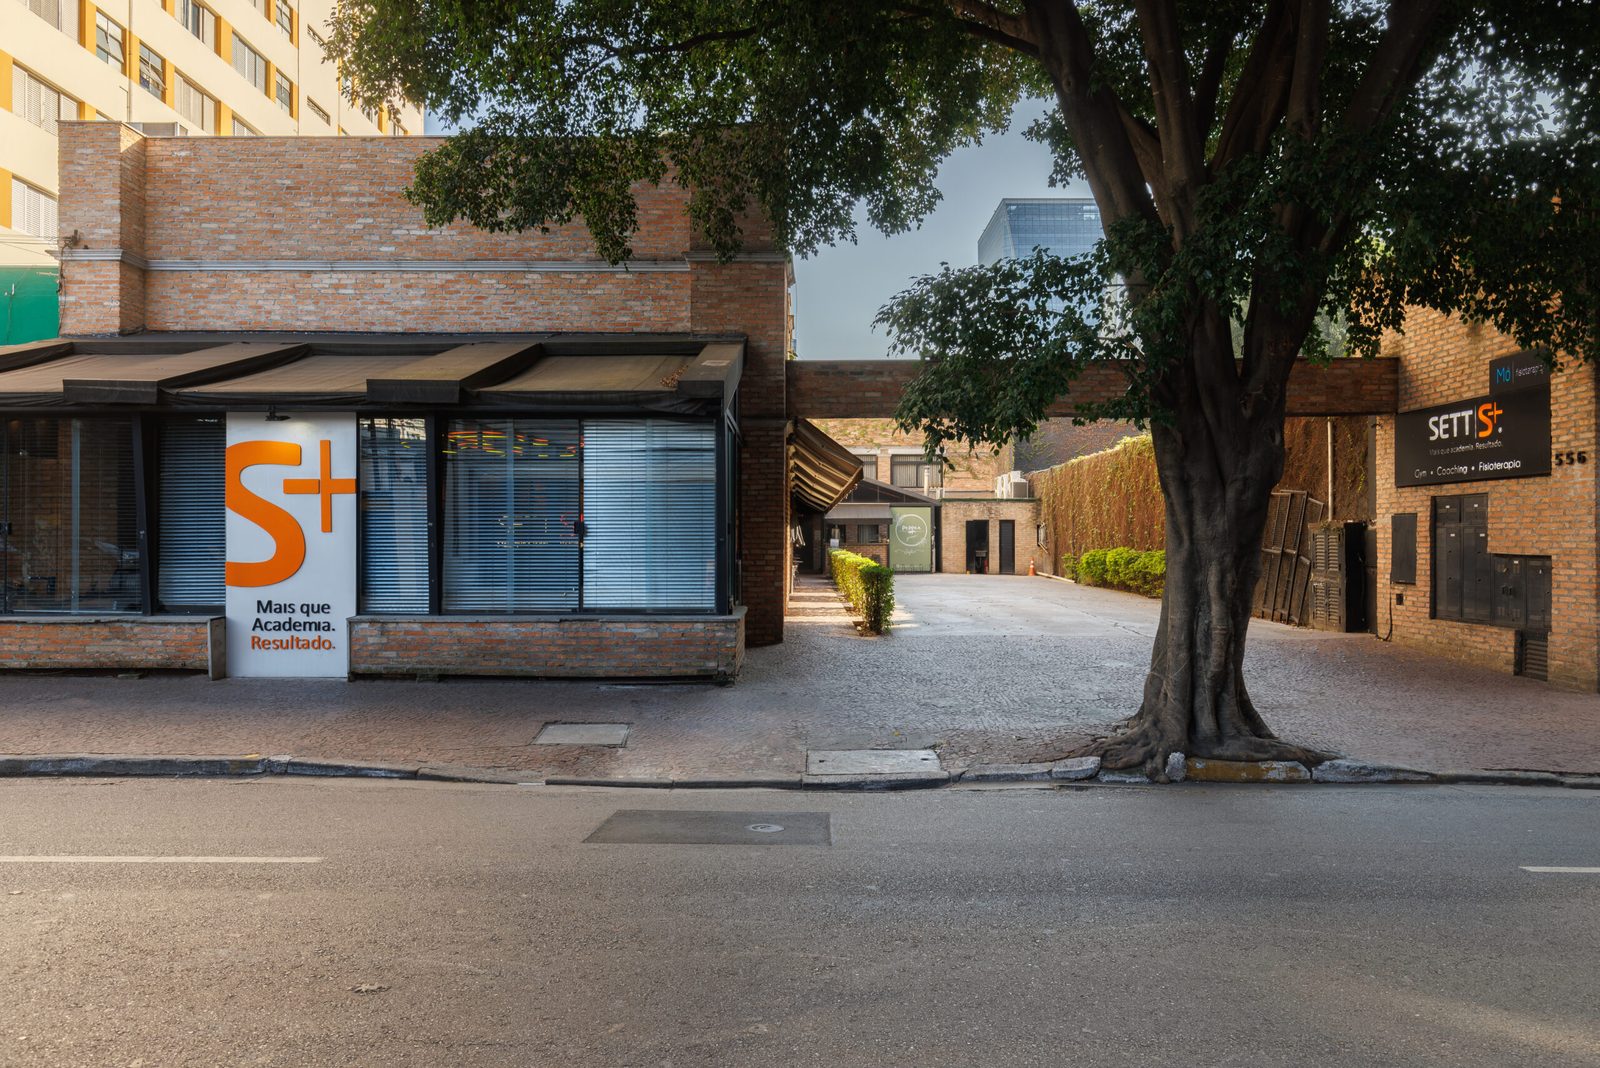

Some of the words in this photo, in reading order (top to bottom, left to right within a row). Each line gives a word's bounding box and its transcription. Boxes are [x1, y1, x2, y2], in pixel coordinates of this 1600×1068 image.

[1428, 409, 1473, 441] SETT
[1554, 450, 1587, 466] 556
[1414, 468, 1427, 479] Gym
[1436, 464, 1468, 476] Coaching
[1478, 459, 1521, 472] Fisioterapia
[256, 600, 295, 614] Mais
[300, 602, 331, 617] que
[252, 617, 336, 632] Academia.
[251, 635, 336, 650] Resultado.
